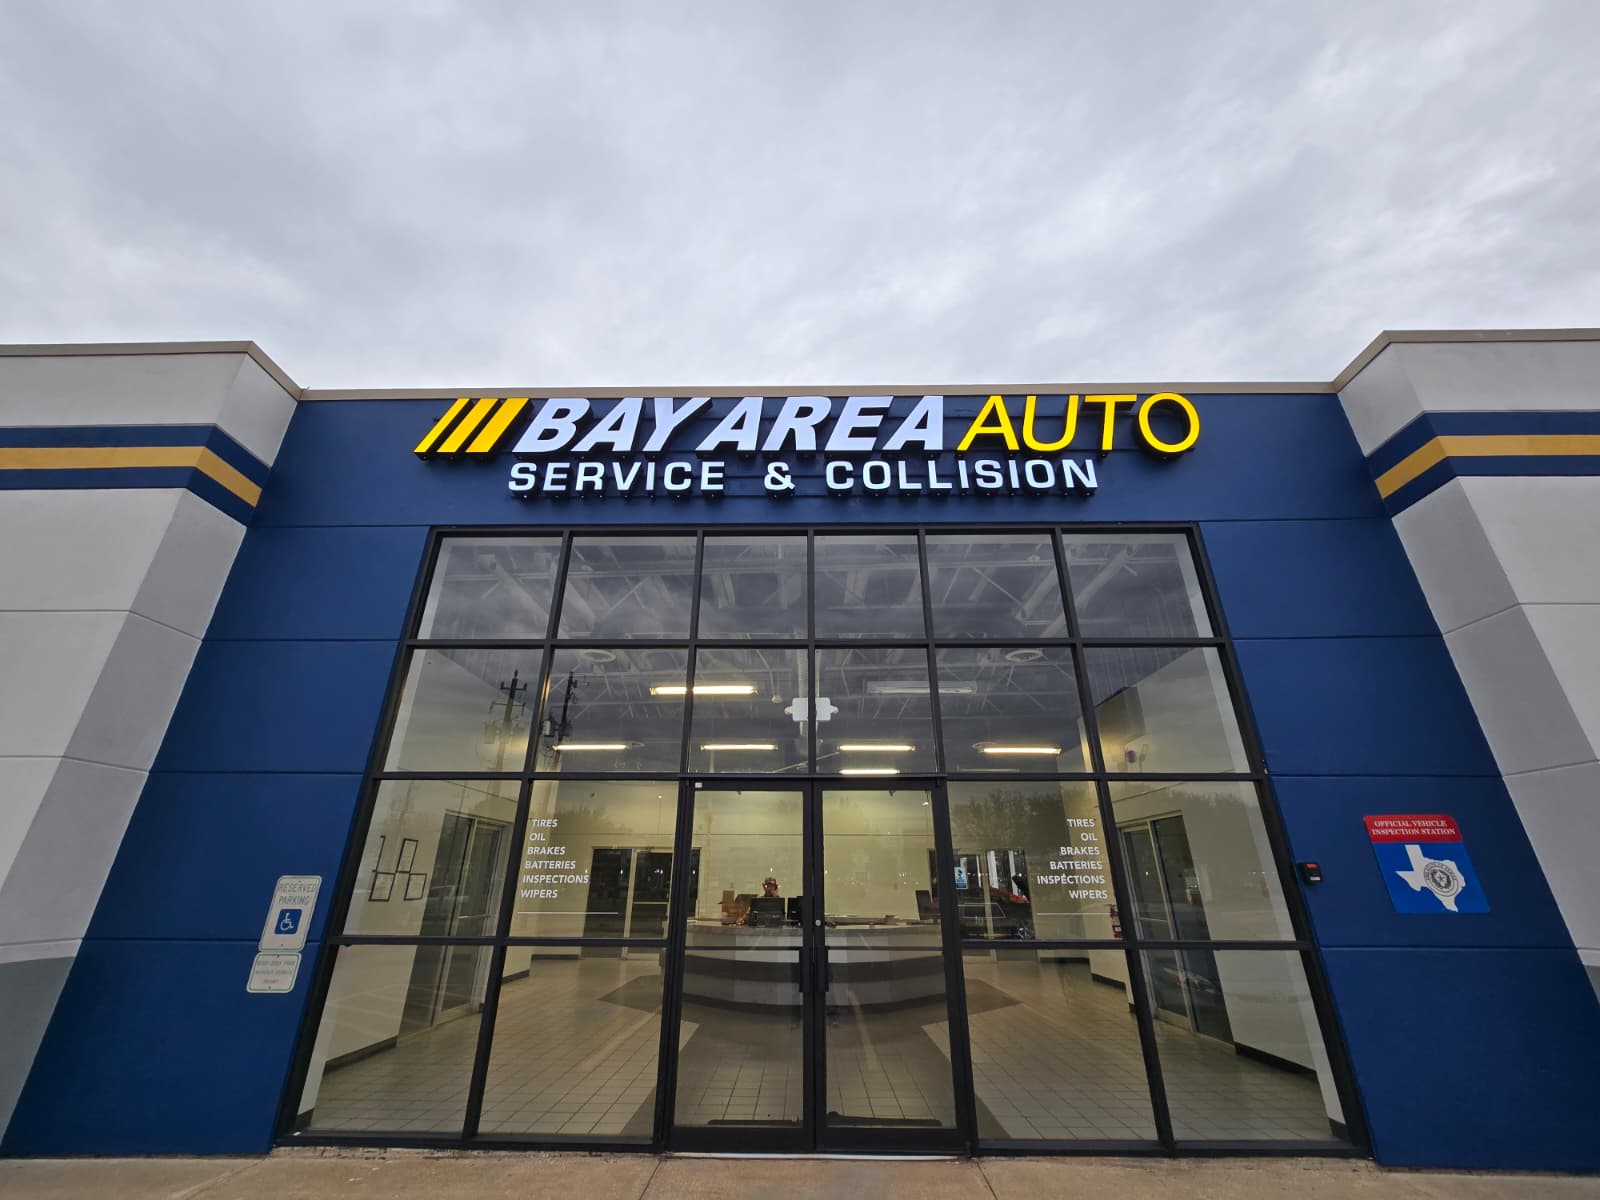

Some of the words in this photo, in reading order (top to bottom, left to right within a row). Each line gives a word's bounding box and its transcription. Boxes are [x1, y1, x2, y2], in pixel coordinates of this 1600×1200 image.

[511, 397, 711, 453] BAY
[695, 395, 944, 453] AREA
[956, 392, 1201, 454] AUTO
[507, 461, 725, 492] SERVICE
[763, 461, 796, 491] &
[825, 459, 1098, 490] COLLISION
[531, 819, 558, 828] TIRES
[1067, 819, 1095, 828] TIRES
[529, 832, 546, 841] OIL
[1080, 832, 1098, 841] OIL
[527, 846, 566, 855] BRAKES
[1059, 846, 1100, 856] BRAKES
[525, 861, 576, 870] BATTERIES
[1049, 861, 1103, 870] BATTERIES
[522, 875, 589, 884] INSPECTIONS
[1036, 875, 1105, 885] INSPECTIONS
[278, 883, 316, 893] RESERVED
[520, 890, 558, 899] WIPERS
[1068, 890, 1108, 899] WIPERS
[278, 896, 310, 905] PARKING
